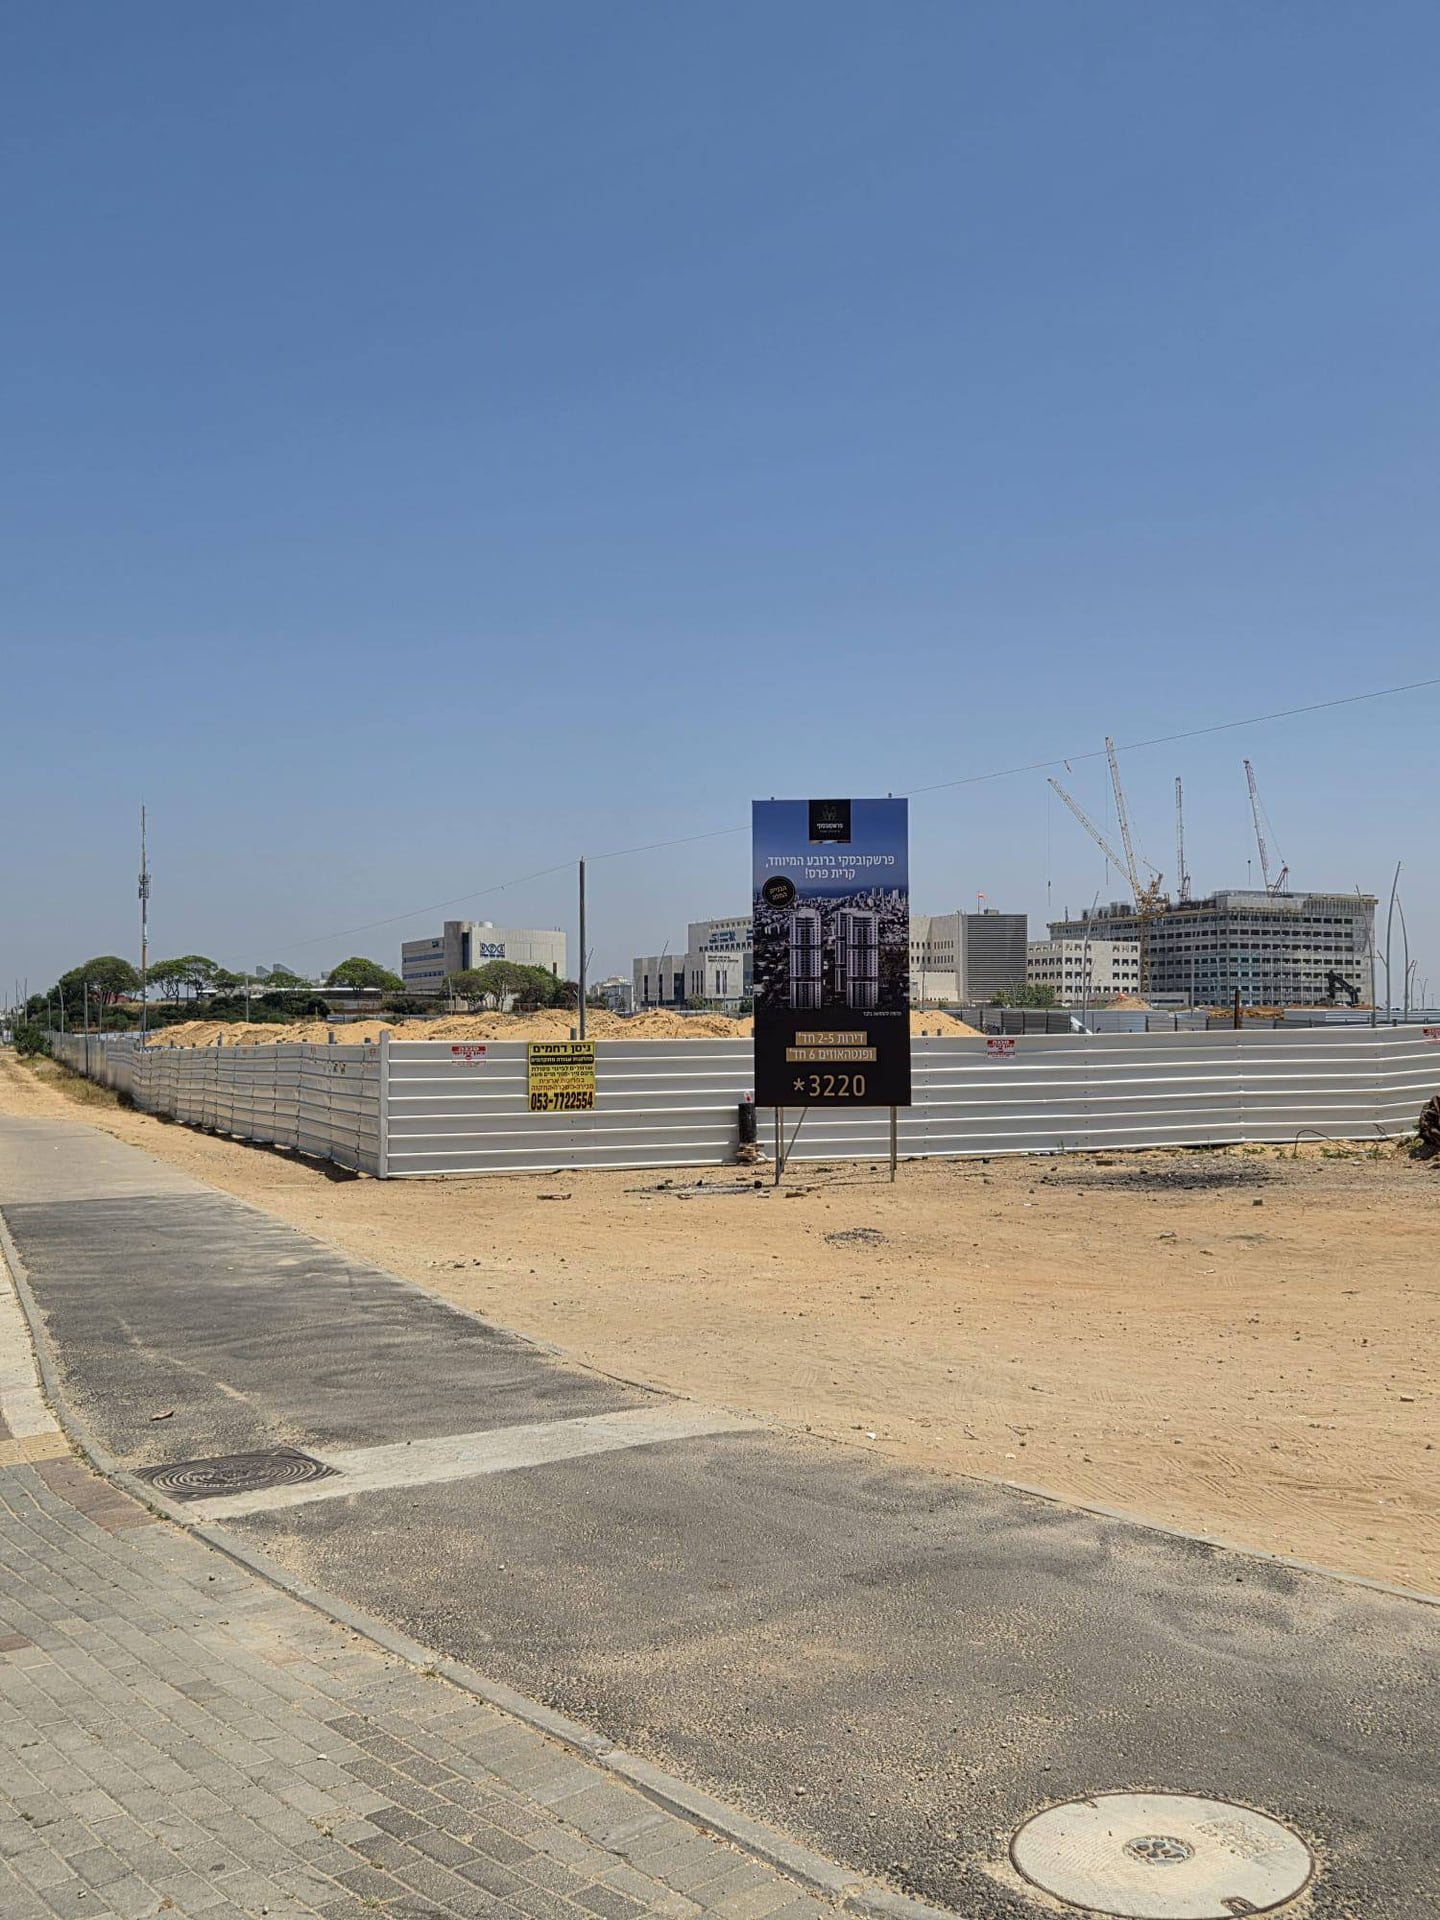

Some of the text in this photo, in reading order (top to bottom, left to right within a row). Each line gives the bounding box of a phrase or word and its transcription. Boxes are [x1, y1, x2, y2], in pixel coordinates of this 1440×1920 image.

[765, 855, 895, 868] פרשקובסקי ברובע המיוחד,
[805, 868, 856, 880] קרית פרס!
[798, 1032, 864, 1044] דירות 2-5 חד'
[533, 1044, 591, 1054] ניסן רחמים
[789, 1048, 873, 1060] ופנטהאוזים 6 חד'
[530, 1091, 594, 1111] 053-7722554
